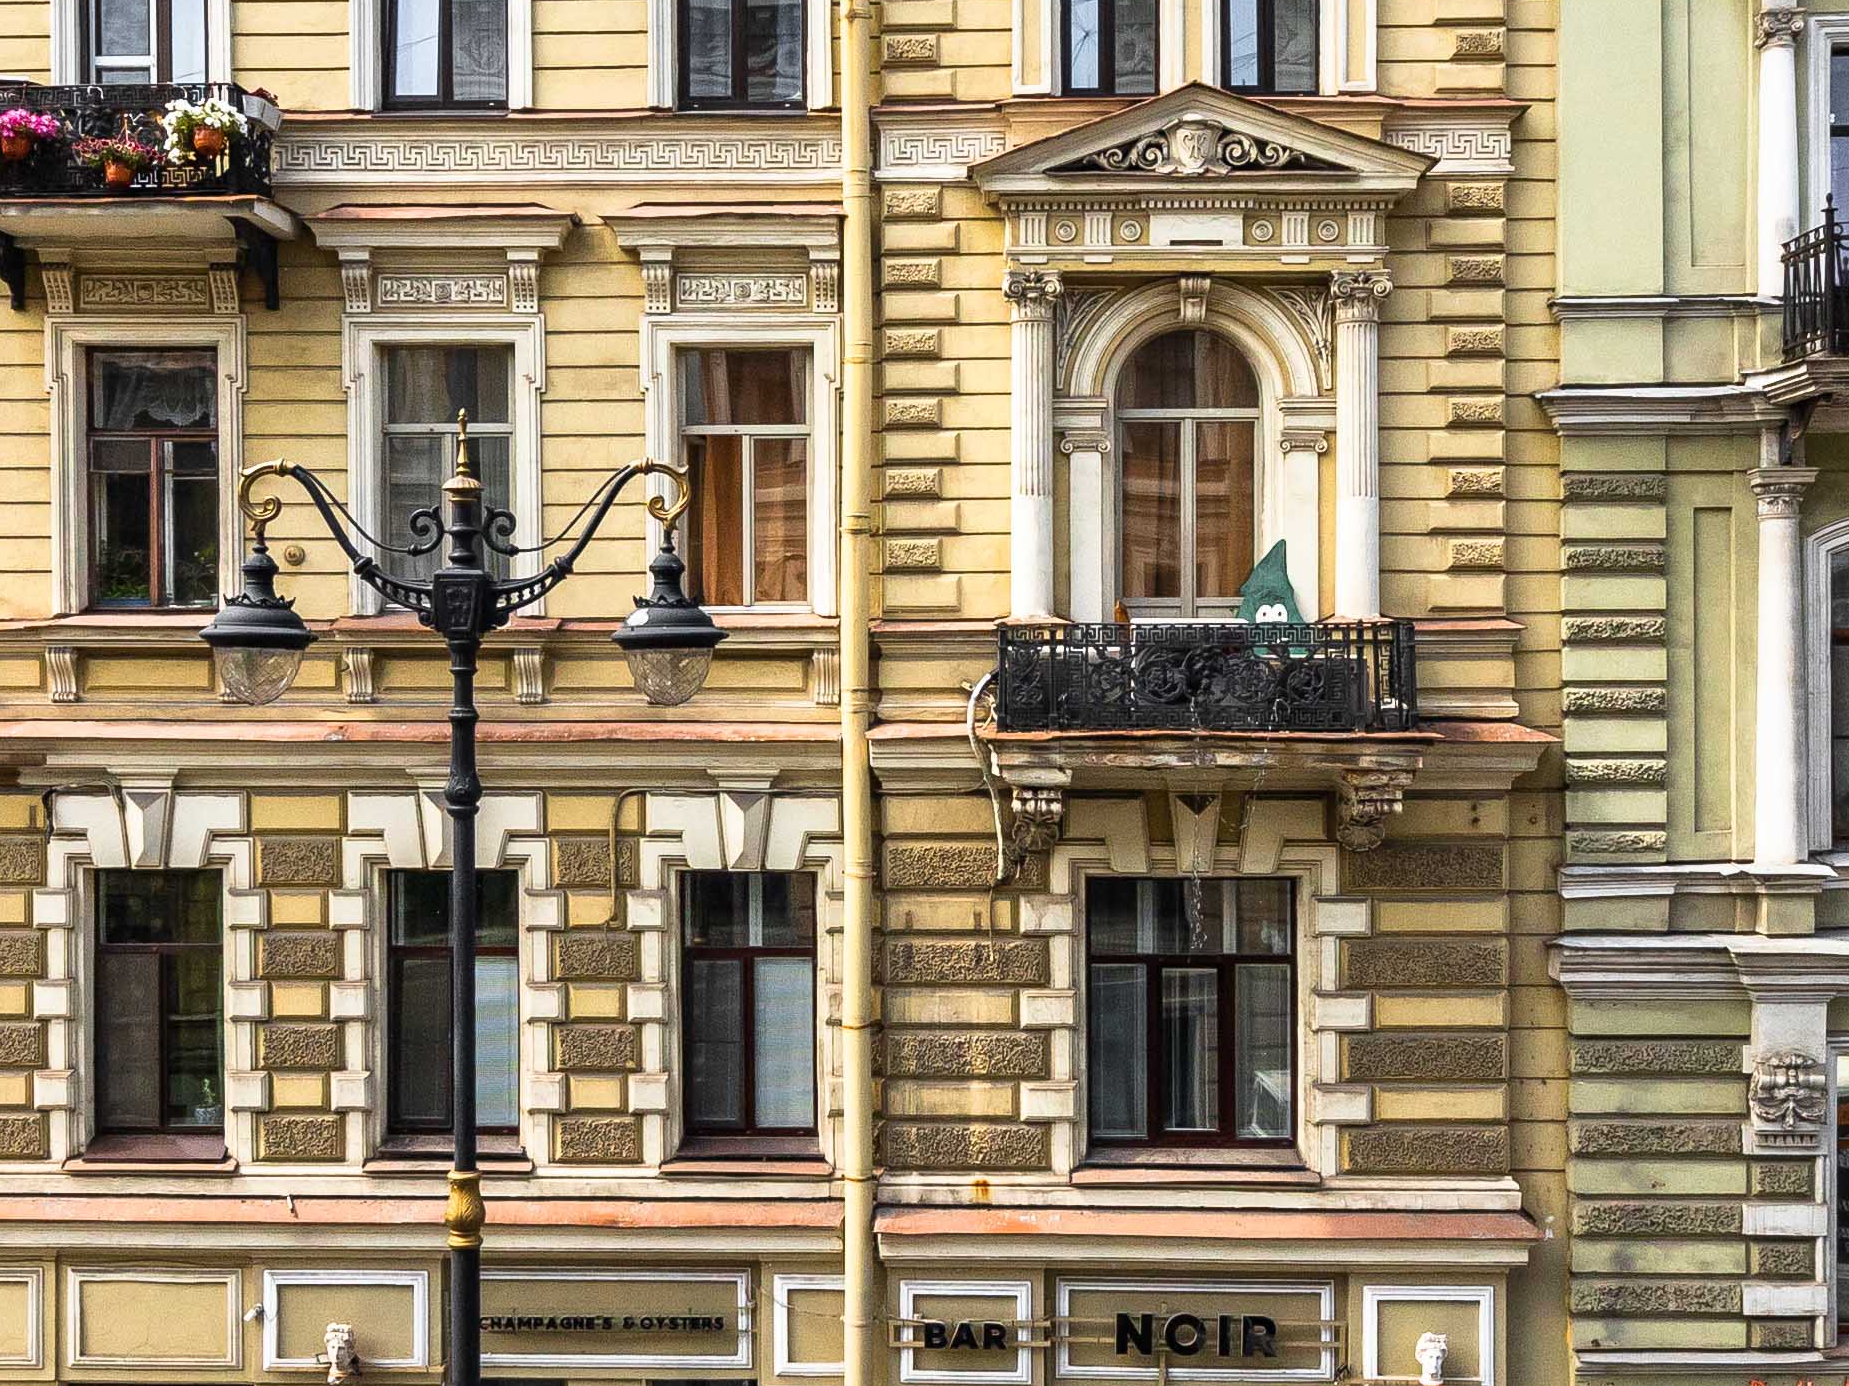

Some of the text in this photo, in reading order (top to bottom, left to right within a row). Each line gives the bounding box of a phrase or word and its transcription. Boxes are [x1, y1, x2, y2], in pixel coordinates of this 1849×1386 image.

[480, 1315, 725, 1331] CHAMPAGNE'S & OYSTERS
[924, 1312, 1277, 1358] BAR NOIR
